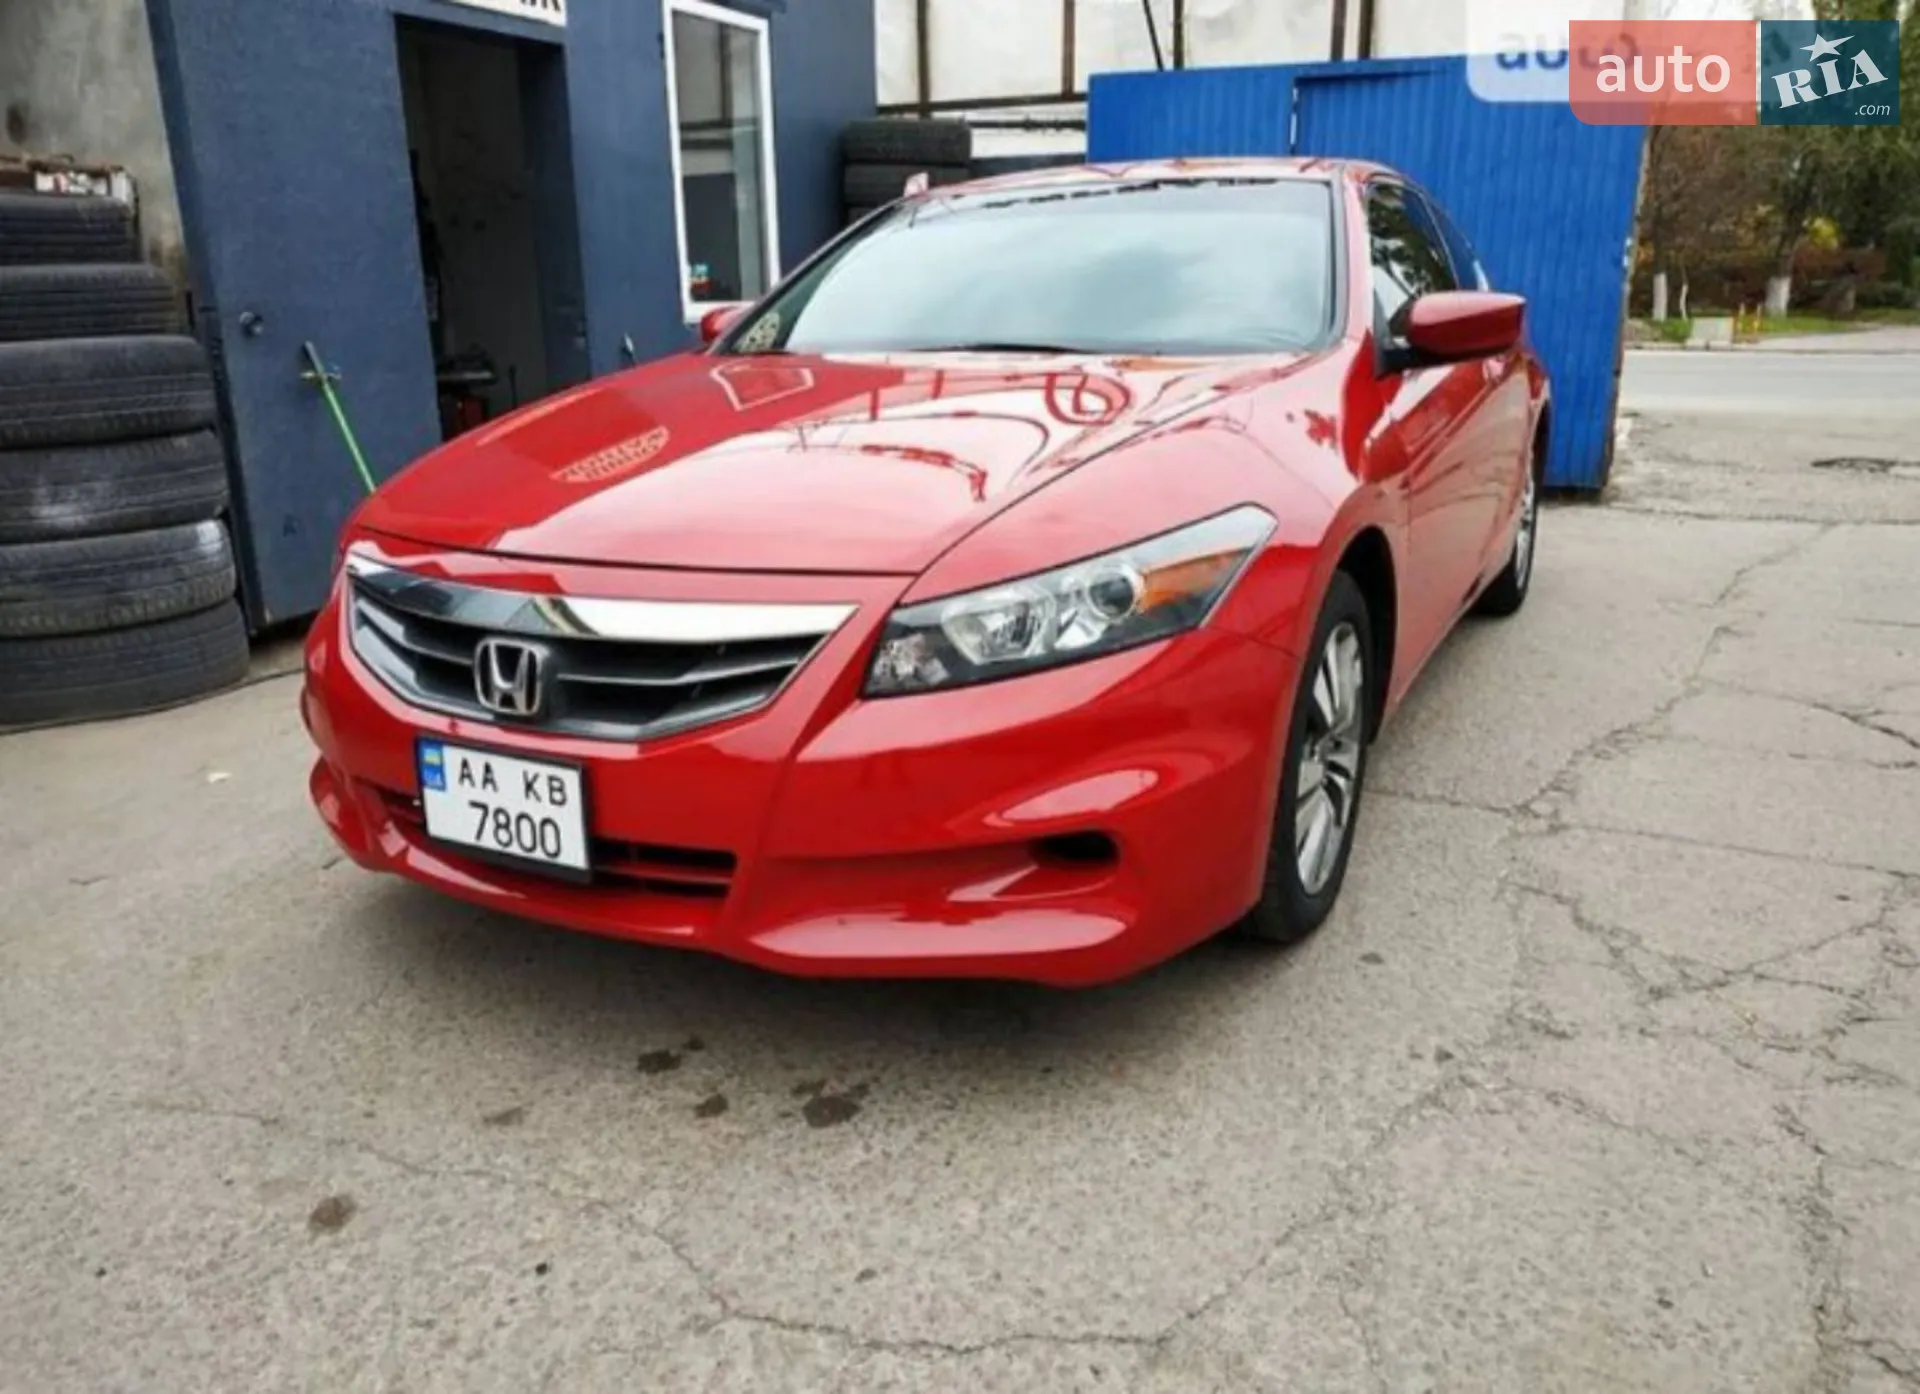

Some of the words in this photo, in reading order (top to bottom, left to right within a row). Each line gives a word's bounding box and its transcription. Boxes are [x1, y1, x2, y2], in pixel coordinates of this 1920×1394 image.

[458, 756, 499, 793] AA
[522, 769, 568, 806] KB
[468, 799, 562, 859] 7800
